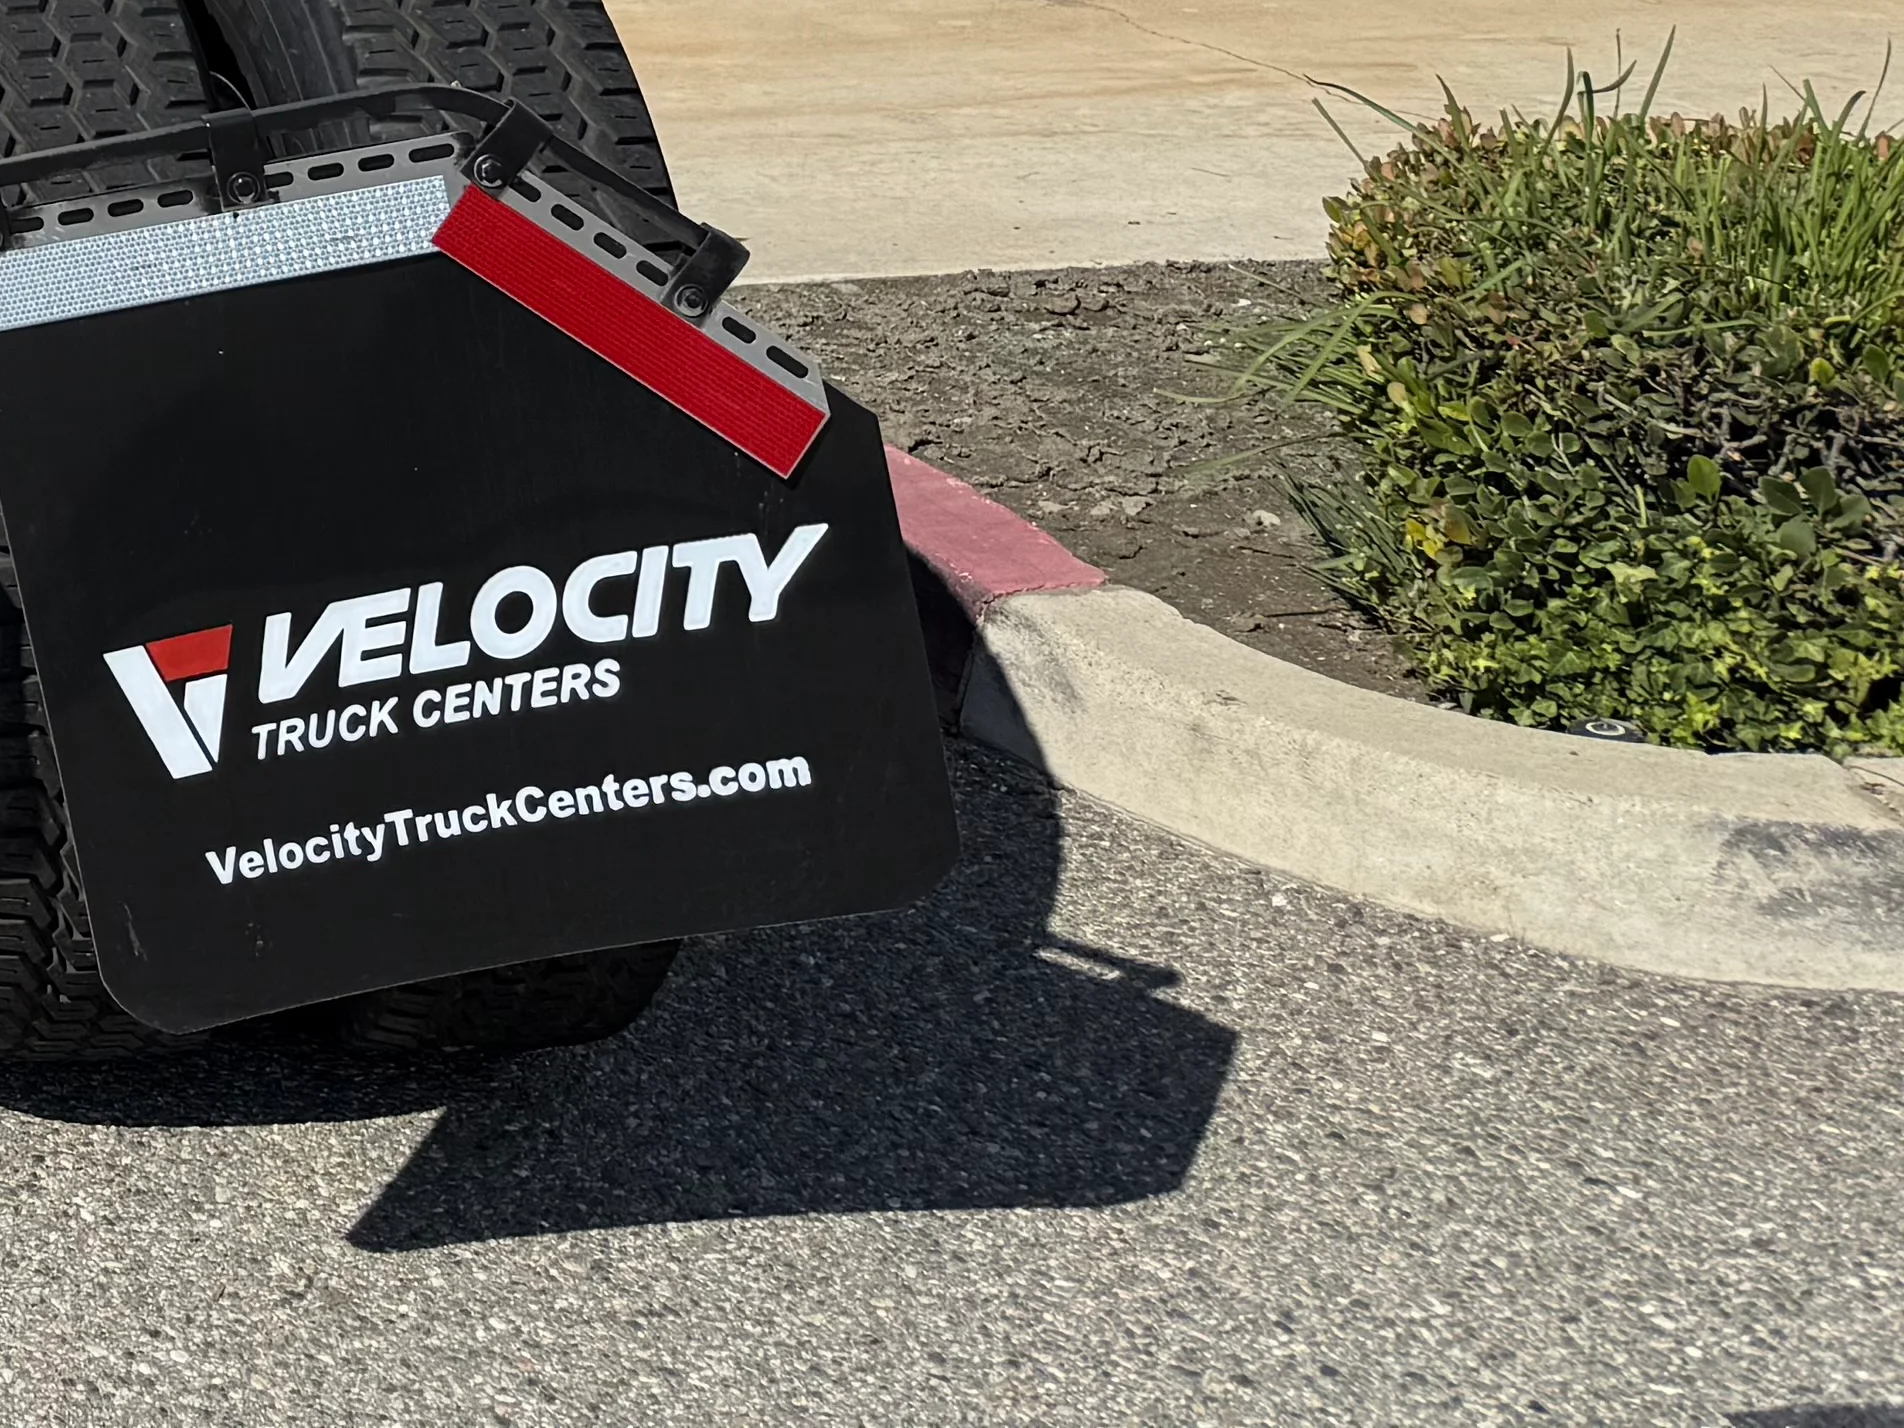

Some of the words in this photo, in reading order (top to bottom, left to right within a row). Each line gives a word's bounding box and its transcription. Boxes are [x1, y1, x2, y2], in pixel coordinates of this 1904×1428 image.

[259, 523, 829, 704] VELOCITY
[252, 697, 399, 760] TRUCK
[413, 658, 621, 732] CENTERS
[204, 756, 813, 885] VelocityTruckCenters.com
